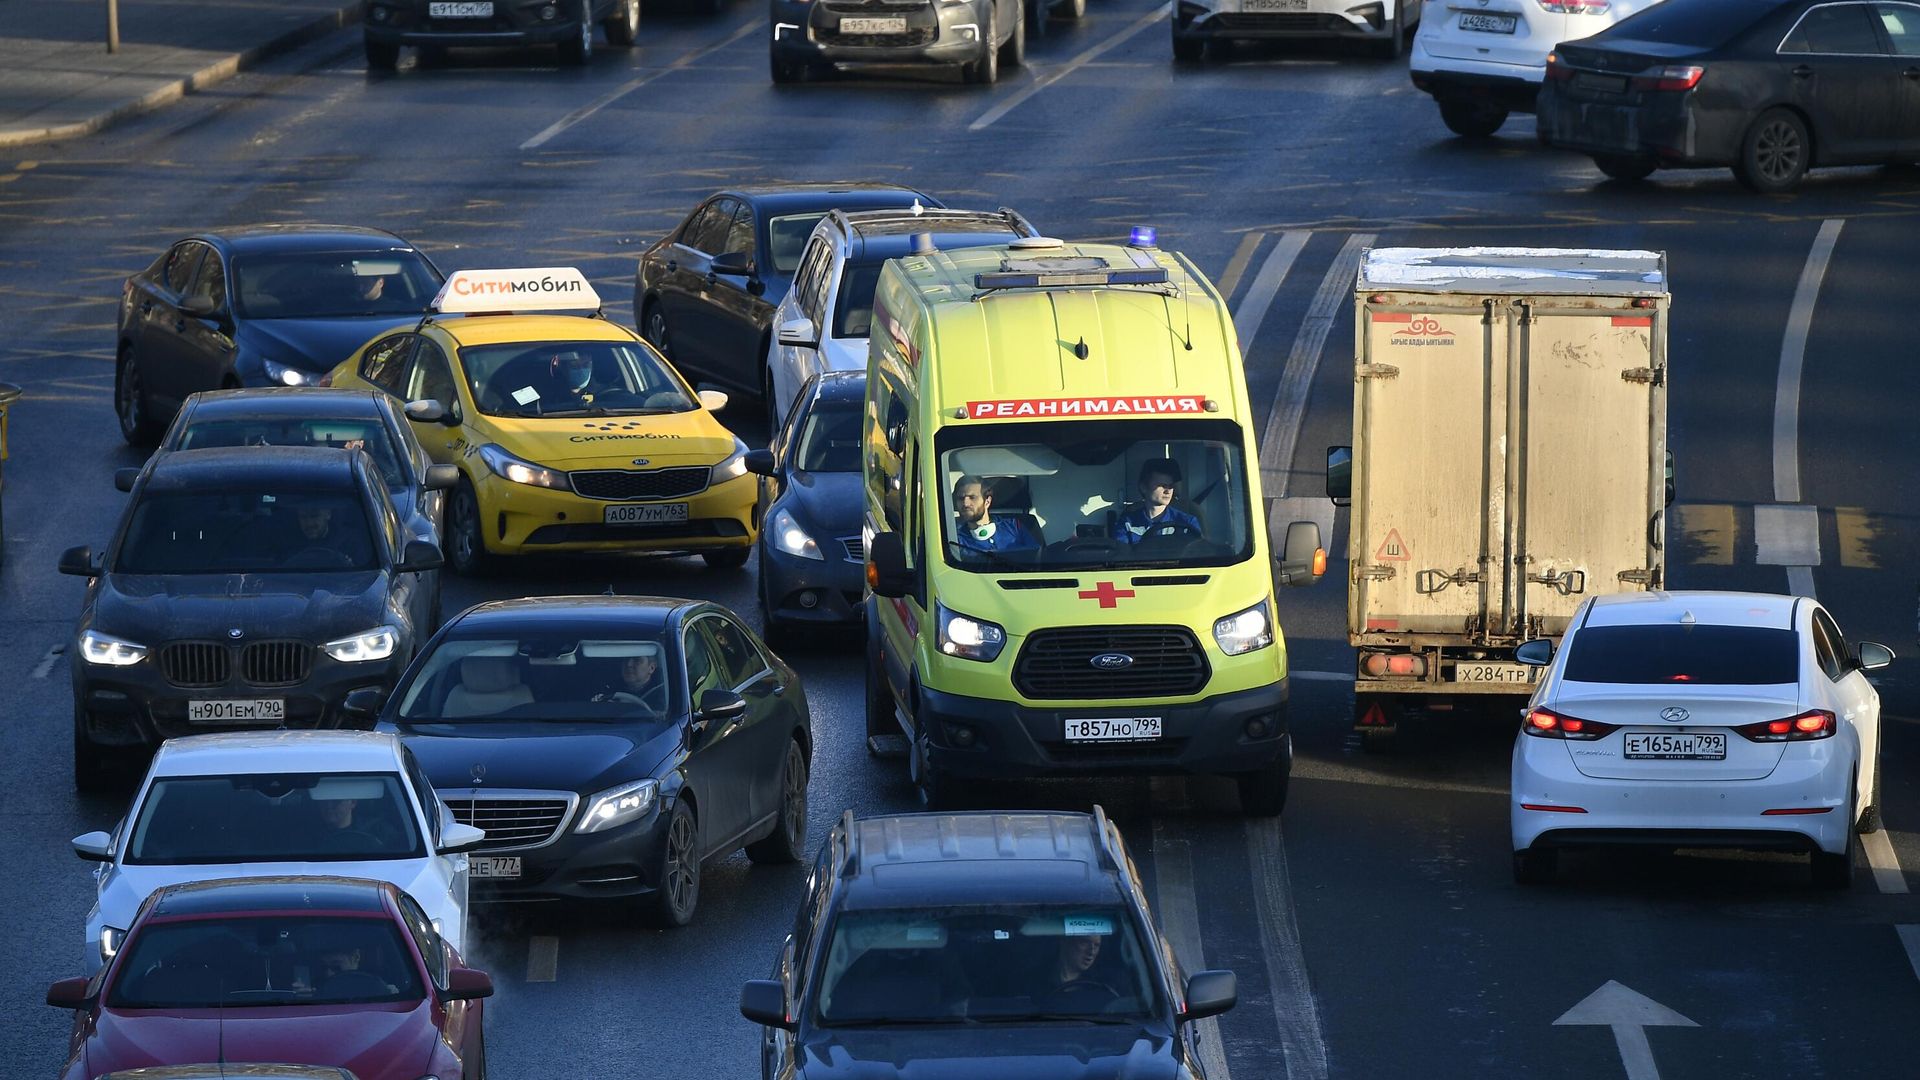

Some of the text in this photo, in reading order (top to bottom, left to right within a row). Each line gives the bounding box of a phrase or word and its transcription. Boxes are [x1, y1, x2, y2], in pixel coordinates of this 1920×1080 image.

[453, 276, 582, 296] Ситимобил
[975, 398, 1199, 417] РЕАНИМАЦИЯ
[569, 432, 682, 443] Ситимобил
[609, 506, 663, 521] А087УМ
[663, 504, 685, 516] 763
[1387, 544, 1399, 555] Ш
[1101, 656, 1124, 666] Ford
[1462, 666, 1526, 682] Х284ТР
[194, 701, 281, 718] Н901ЕМ 790
[1070, 718, 1158, 737] Т857НО 799
[1630, 735, 1721, 753] Е165АН 799
[492, 857, 517, 870] 777
